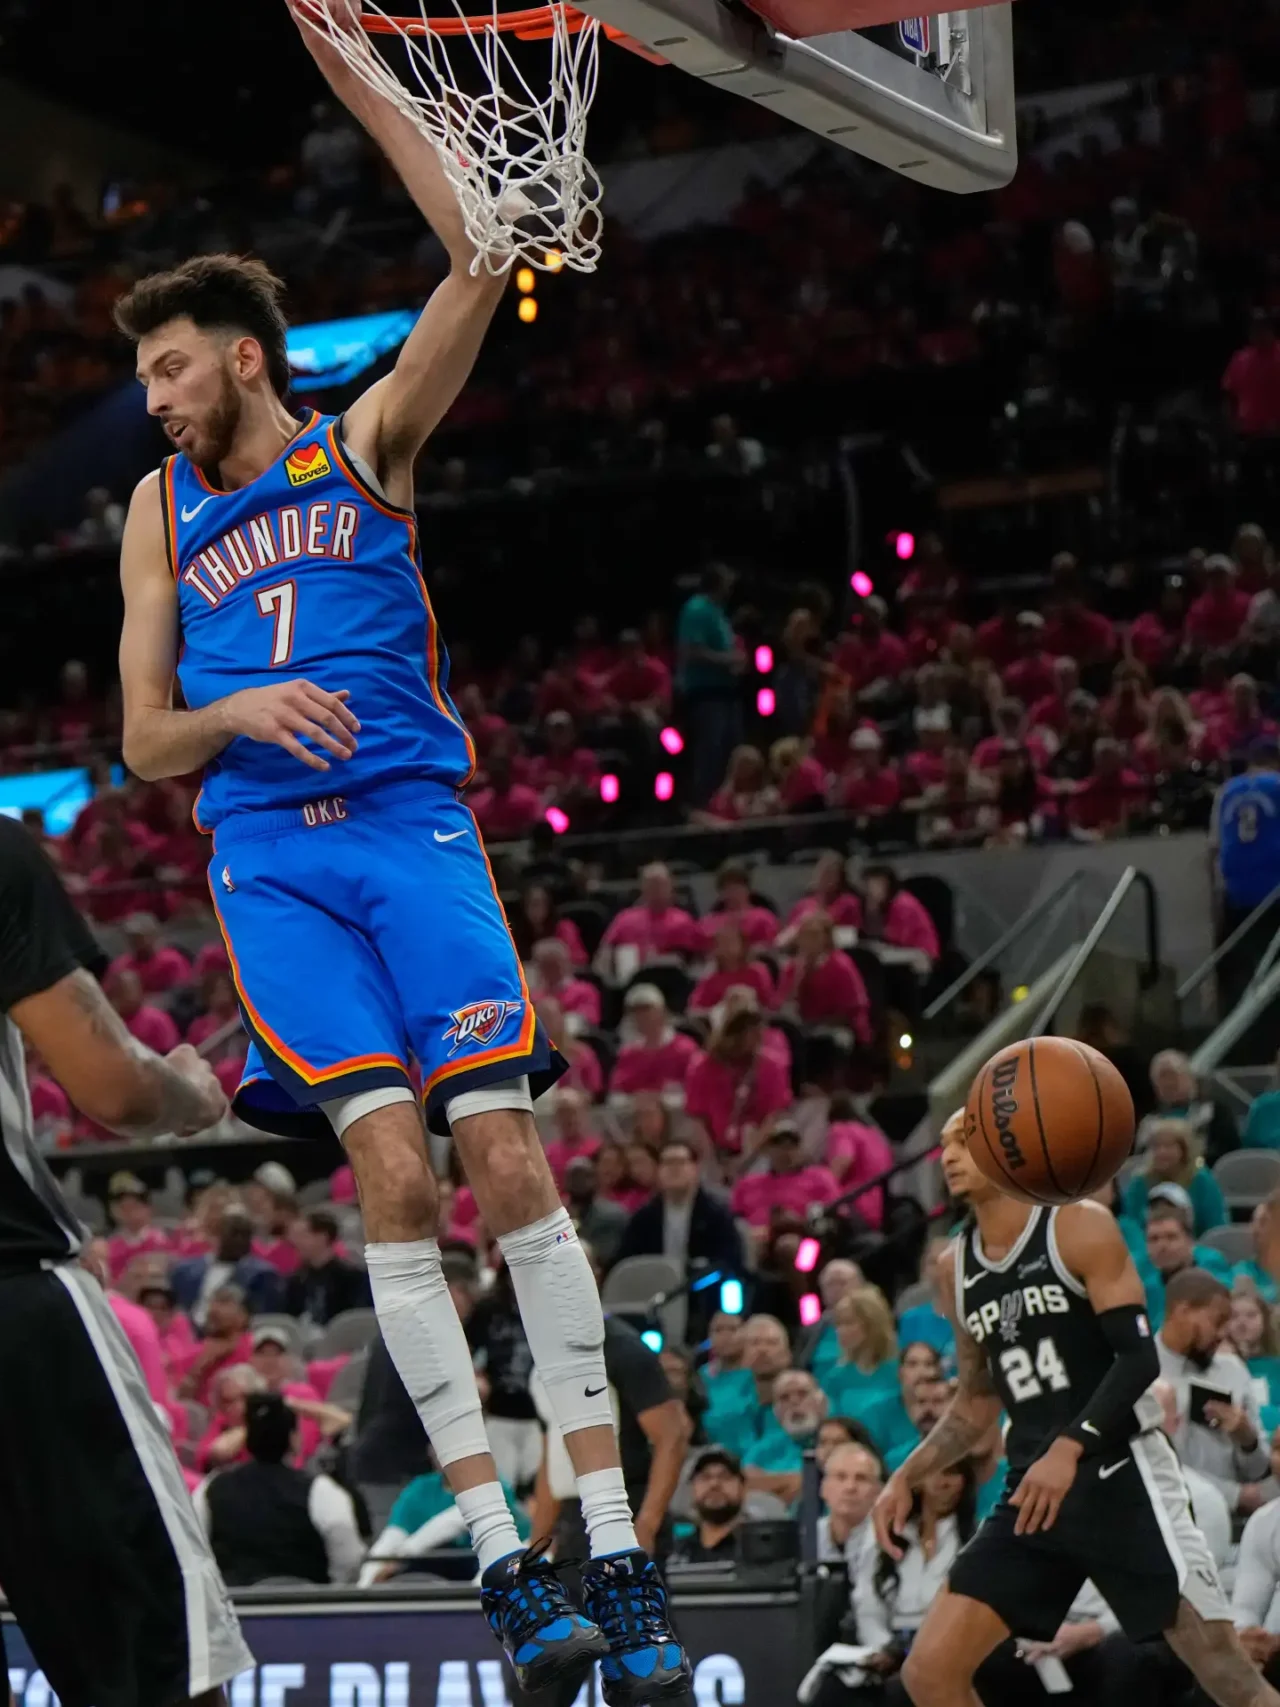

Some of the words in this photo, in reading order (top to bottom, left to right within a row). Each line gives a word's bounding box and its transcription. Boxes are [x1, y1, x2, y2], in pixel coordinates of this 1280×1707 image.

[184, 502, 359, 607] THUNDER
[254, 578, 297, 668] 7
[303, 797, 347, 827] OKC
[457, 1005, 495, 1041] OKC
[992, 1056, 1027, 1170] Wilson
[999, 1337, 1070, 1403] 24
